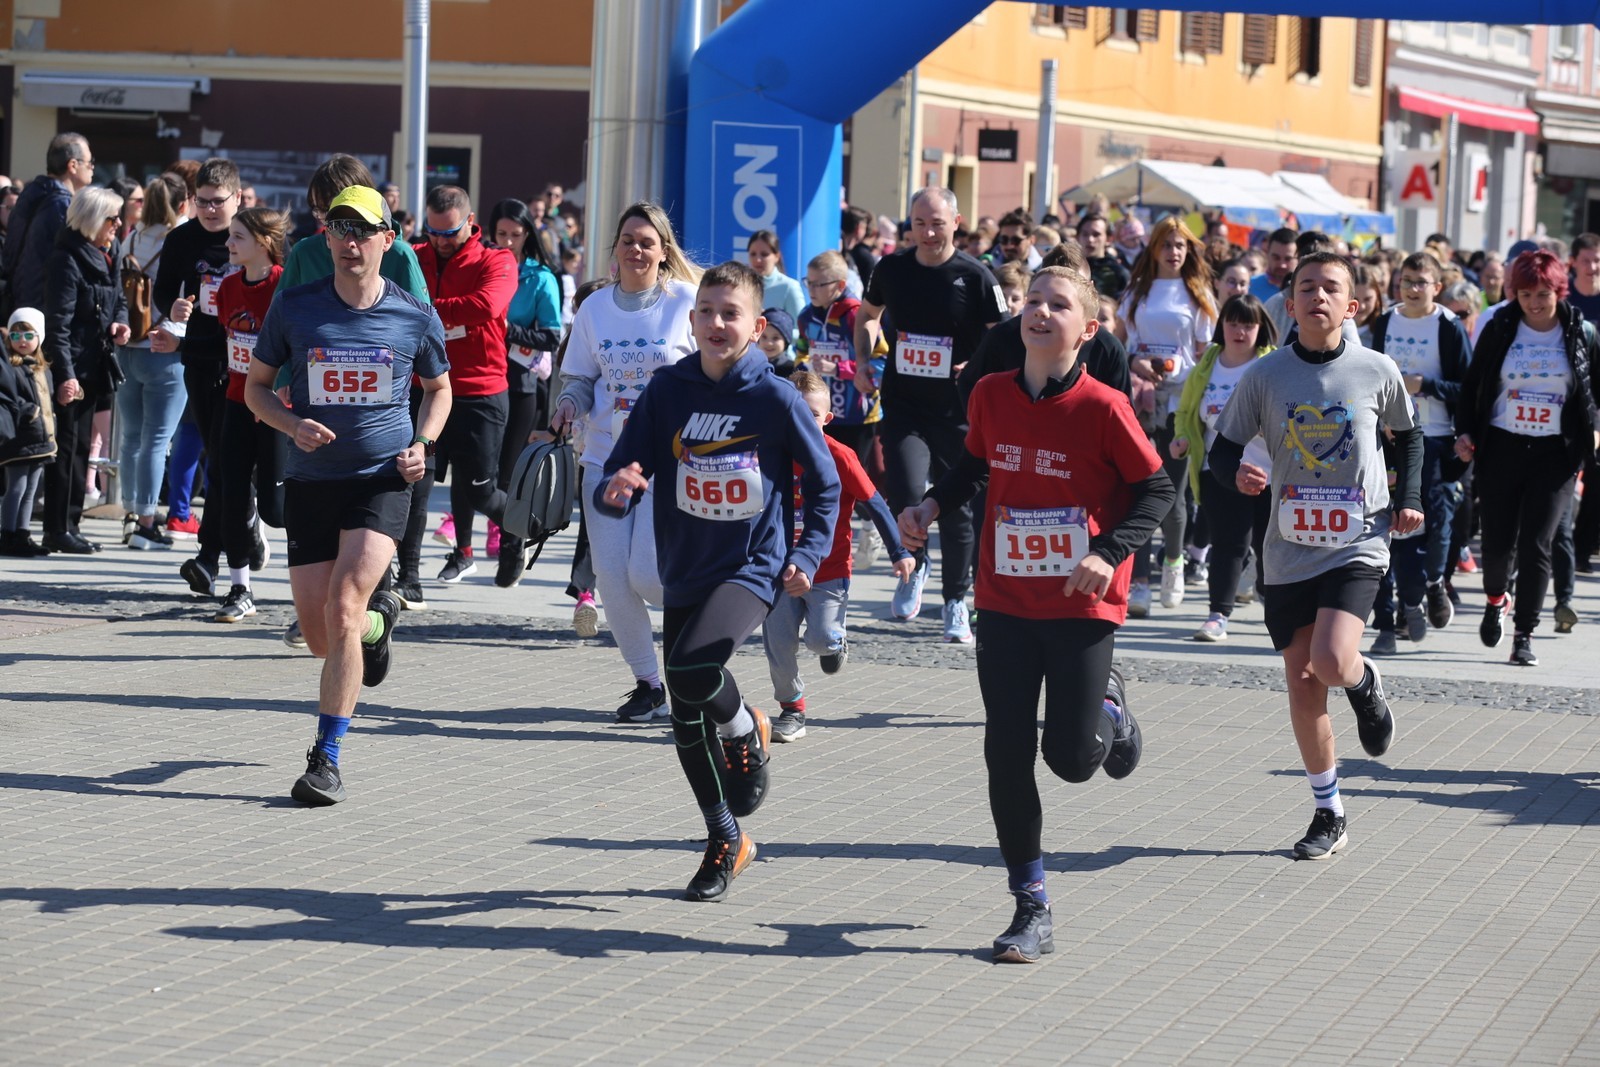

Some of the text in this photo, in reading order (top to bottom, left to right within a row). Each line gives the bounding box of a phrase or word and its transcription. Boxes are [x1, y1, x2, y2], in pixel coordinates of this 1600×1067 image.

[621, 351, 645, 364] SMO
[653, 351, 666, 363] MI
[903, 348, 941, 367] 419
[1529, 349, 1550, 359] SMO
[323, 370, 378, 392] 652
[1515, 406, 1551, 423] 112
[681, 412, 741, 442] NIKE
[996, 443, 1022, 455] ATLETSKI
[1036, 449, 1067, 462] ATHLETIC
[1005, 453, 1021, 464] KLUB
[1035, 457, 1051, 468] CLUB
[685, 475, 748, 504] 660
[1293, 509, 1348, 532] 110
[1007, 533, 1072, 560] 194
